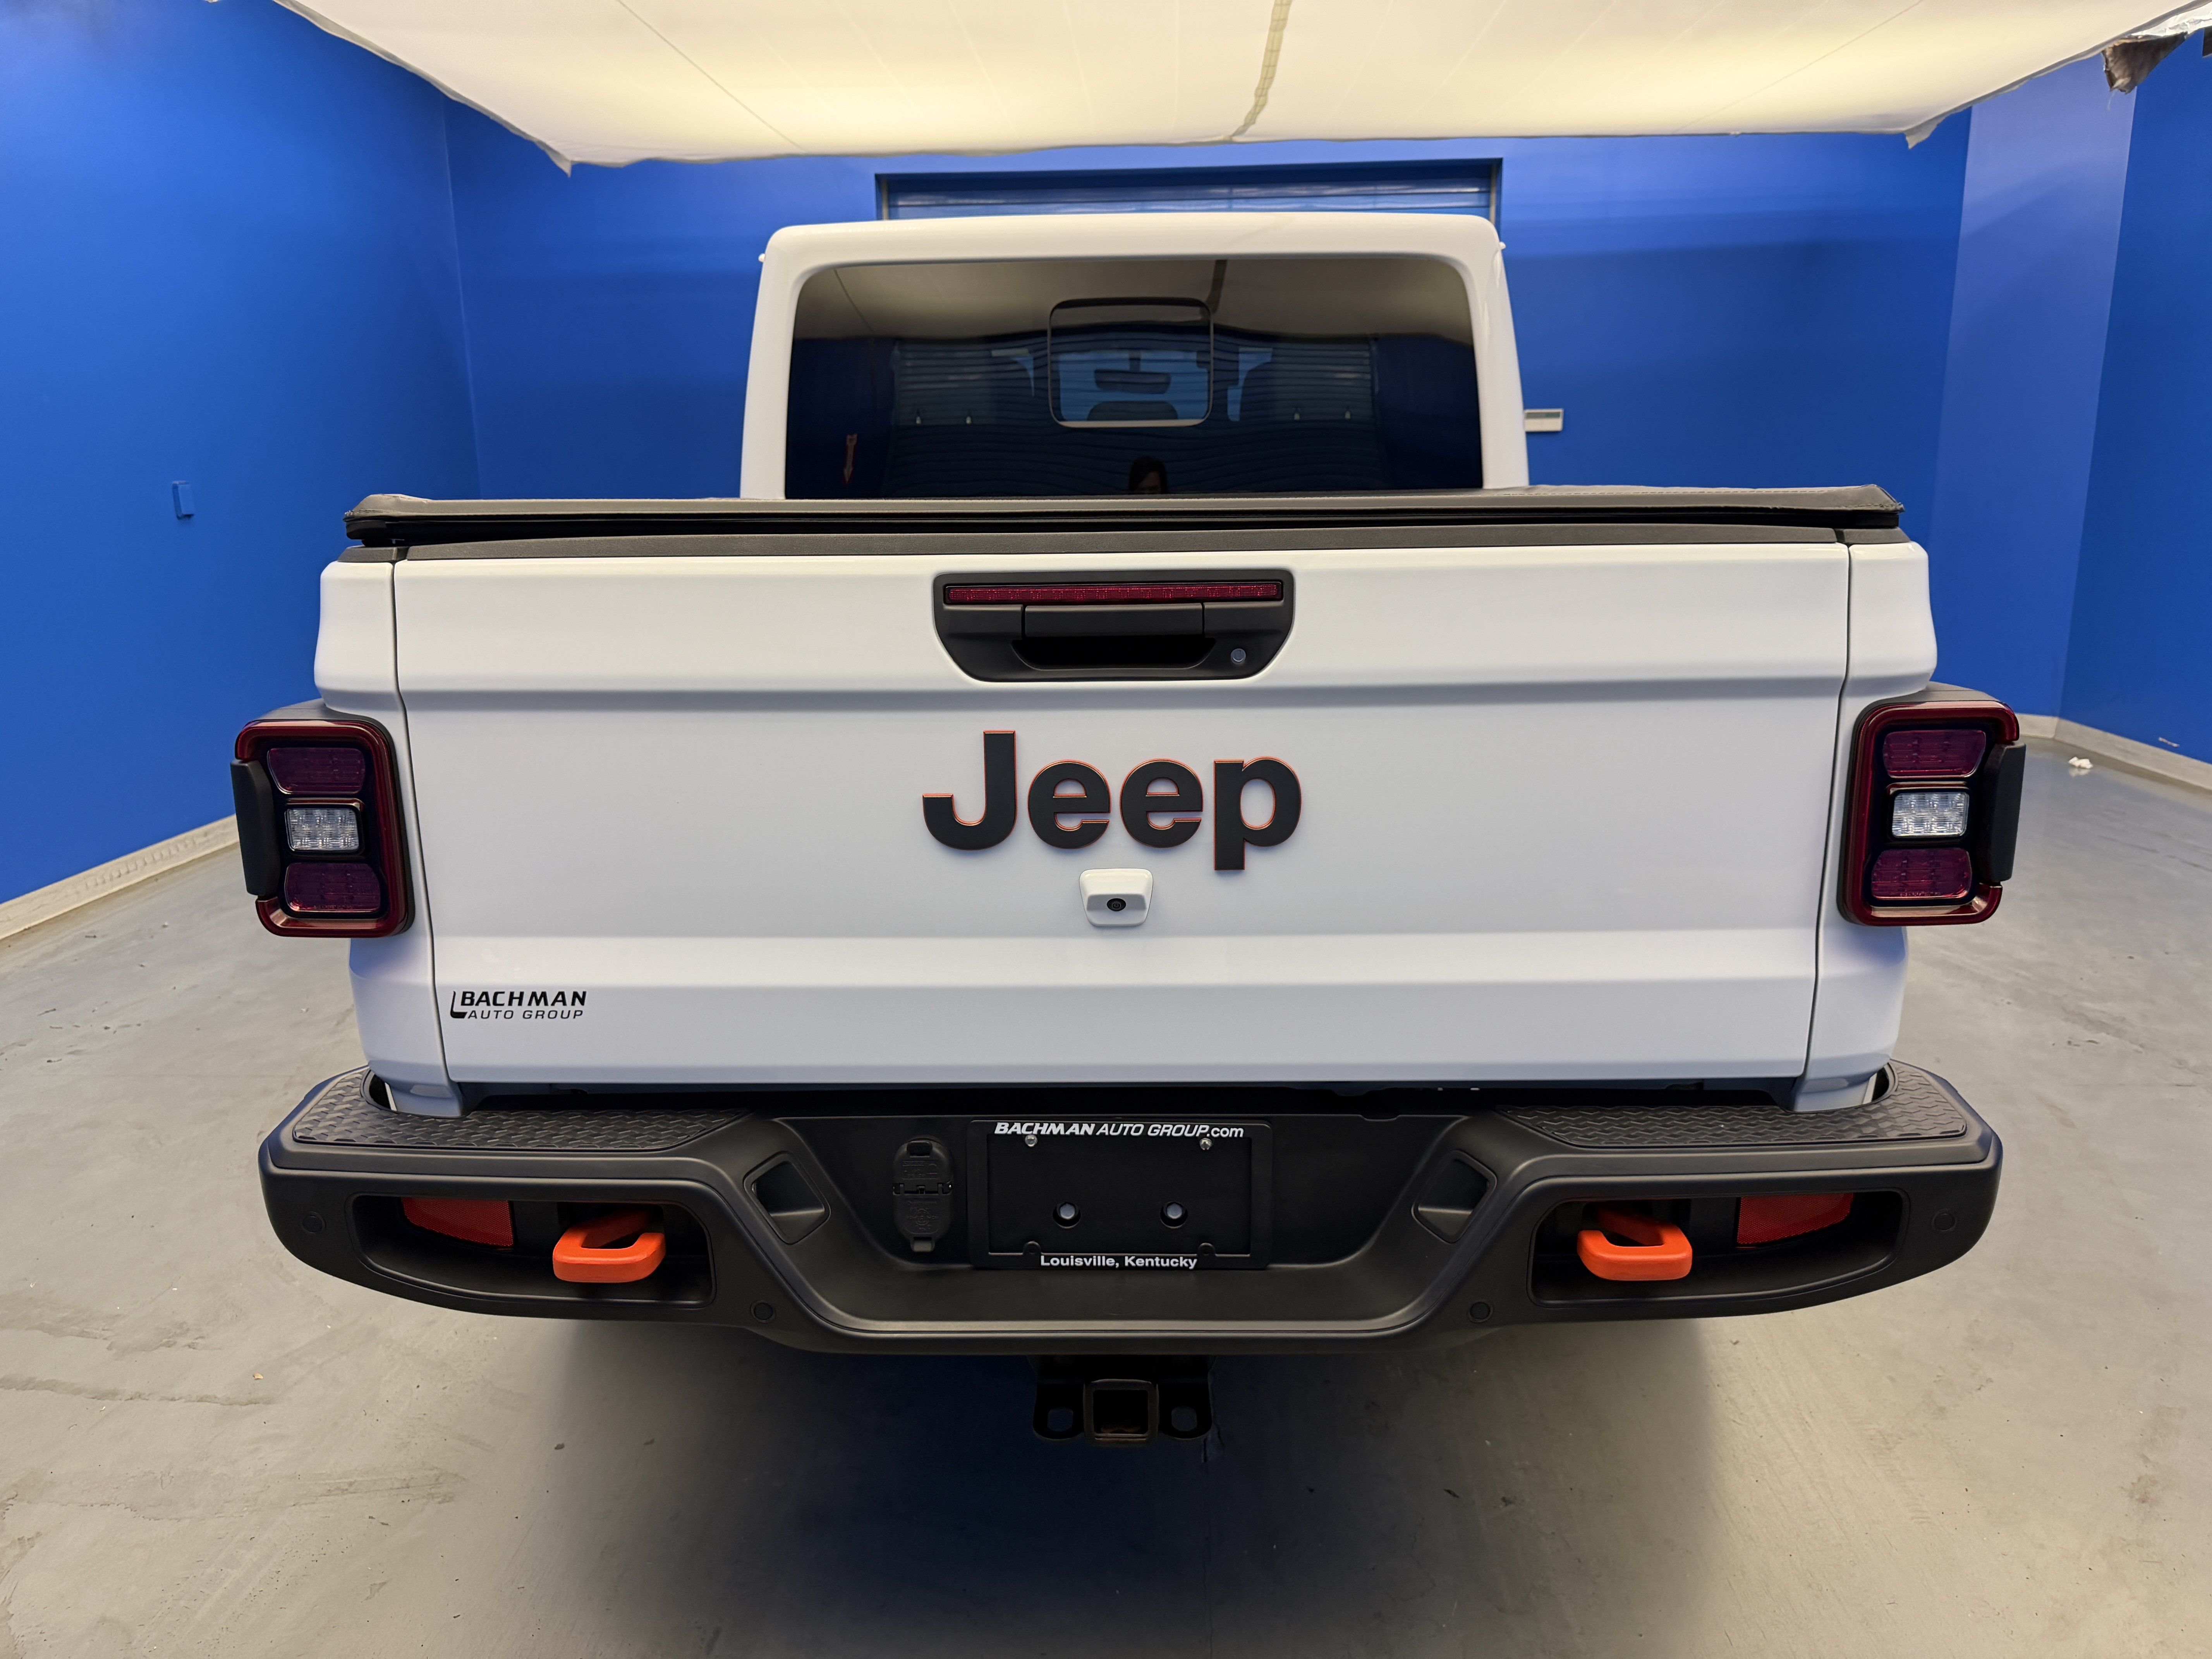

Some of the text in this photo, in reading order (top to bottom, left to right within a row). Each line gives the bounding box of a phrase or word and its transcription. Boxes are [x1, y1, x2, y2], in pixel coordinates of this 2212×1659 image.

[922, 730, 1302, 871] Jeep
[460, 991, 587, 1006] BACHMAN
[467, 1010, 584, 1019] AUTO GROUP
[994, 1121, 1244, 1137] BACHMAN AUTO GROUP.com
[1040, 1255, 1197, 1270] Louisville, Kentucky
